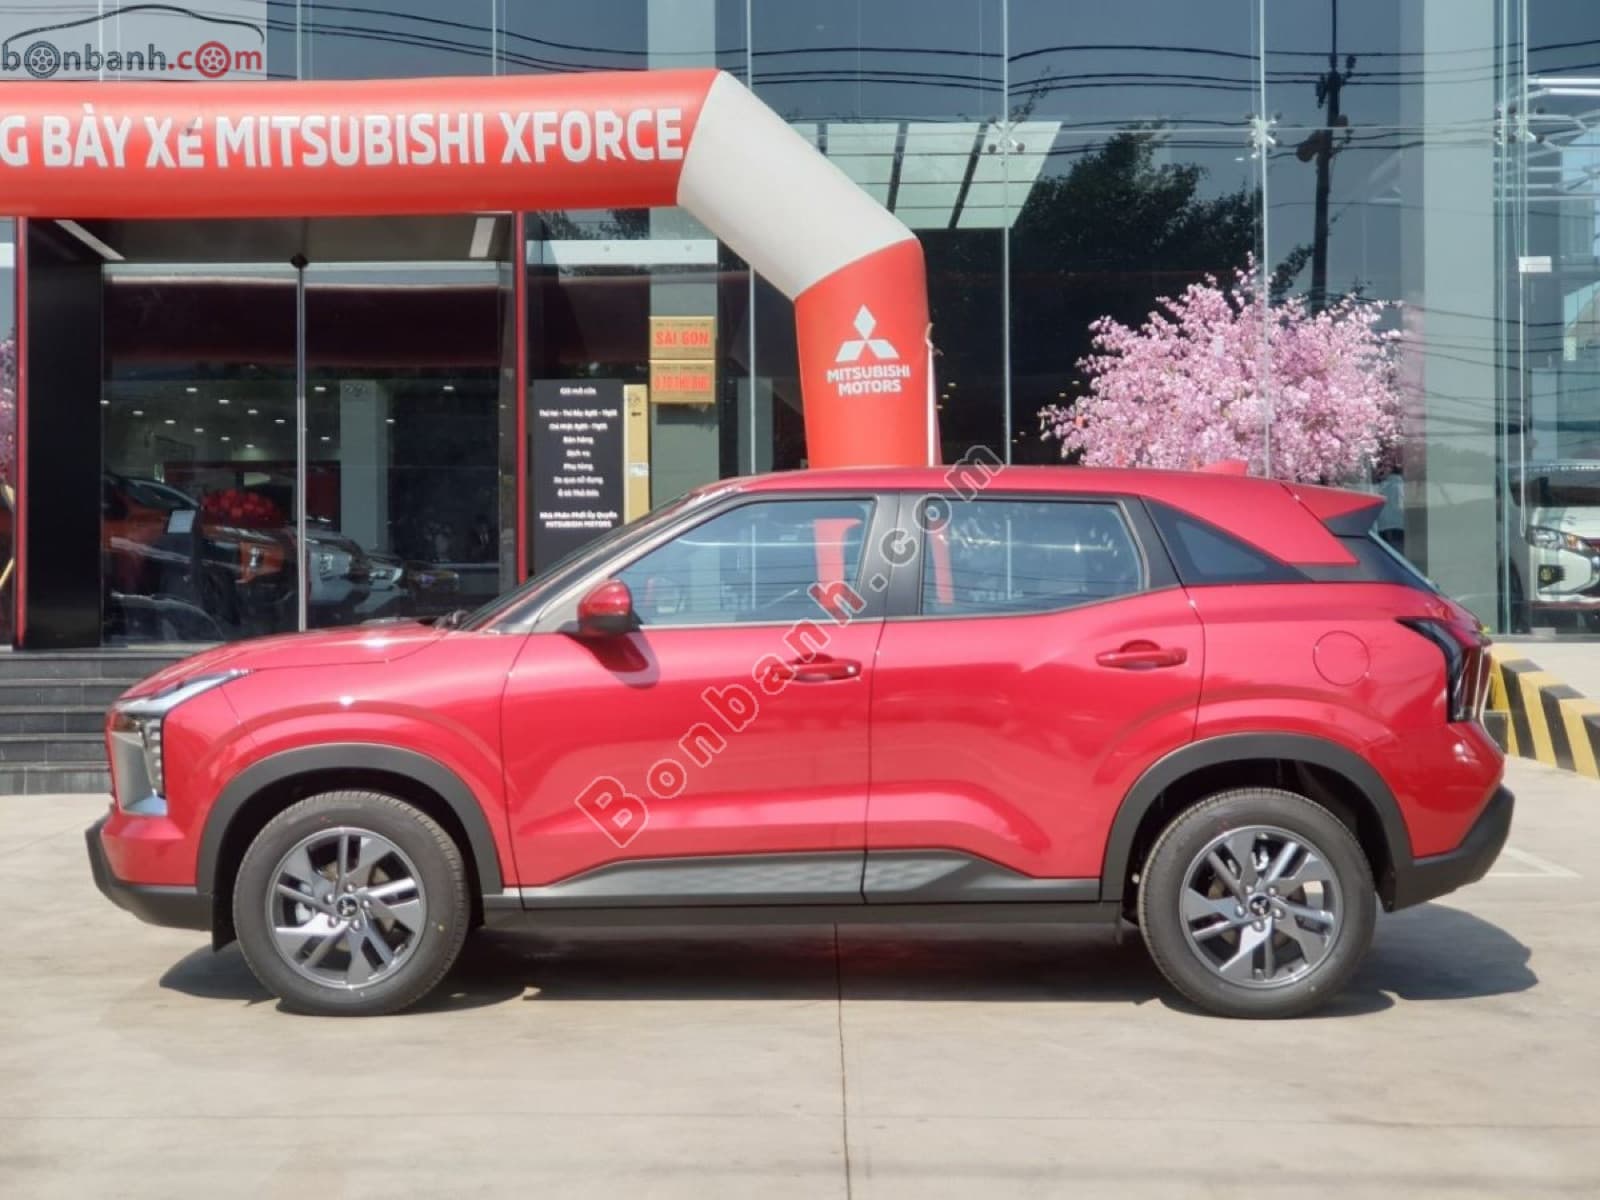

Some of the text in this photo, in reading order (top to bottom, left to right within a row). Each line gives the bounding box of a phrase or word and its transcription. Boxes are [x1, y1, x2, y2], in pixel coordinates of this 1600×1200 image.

[43, 102, 132, 168] BÀY
[215, 112, 486, 168] MITSUBISHI
[499, 107, 684, 164] XFORCE
[826, 364, 911, 384] MITSUBISHI
[838, 379, 902, 396] MOTORS
